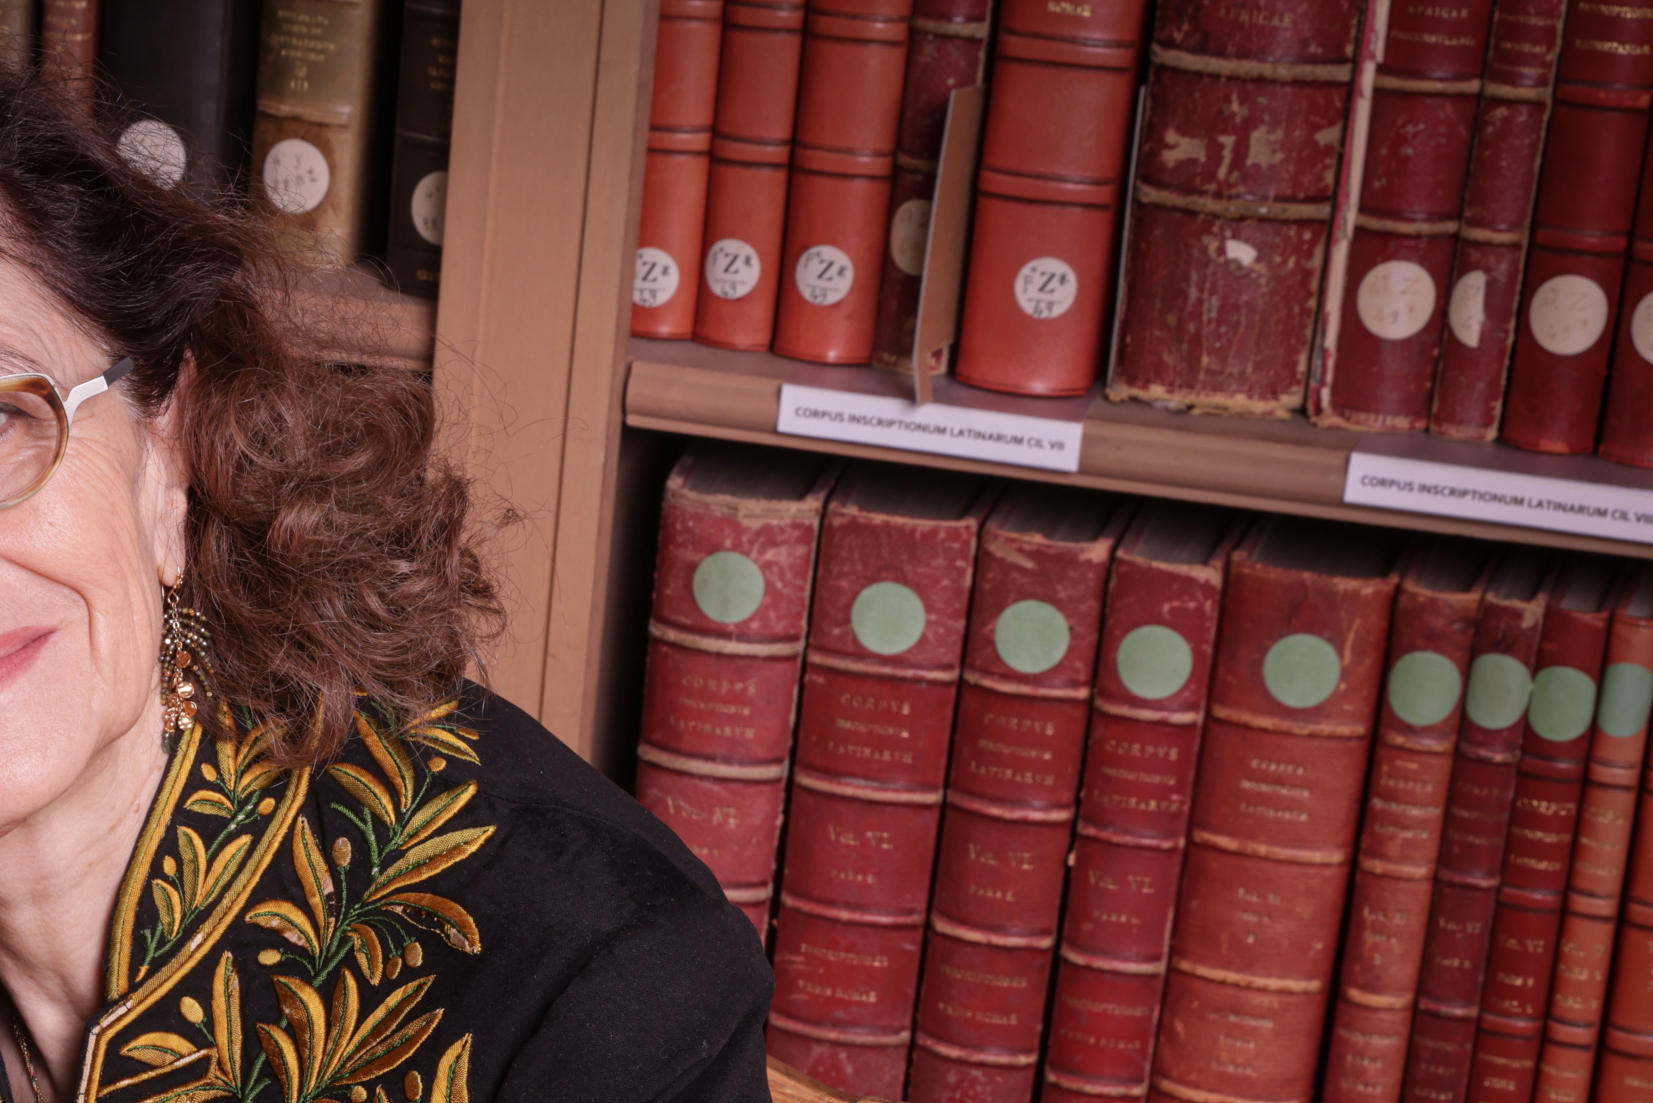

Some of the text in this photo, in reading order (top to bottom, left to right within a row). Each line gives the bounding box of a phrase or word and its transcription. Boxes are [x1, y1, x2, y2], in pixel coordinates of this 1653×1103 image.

[794, 405, 845, 423] CORPUS
[847, 412, 948, 436] INSCRIPTIONUM
[949, 425, 1024, 446] LATINARUM
[1026, 436, 1047, 450] CIL
[1359, 473, 1415, 493] CORPUS
[1417, 482, 1525, 508] INSCRIPTIONUM
[1527, 496, 1609, 519] LATINARUM
[1610, 507, 1632, 523] CIL
